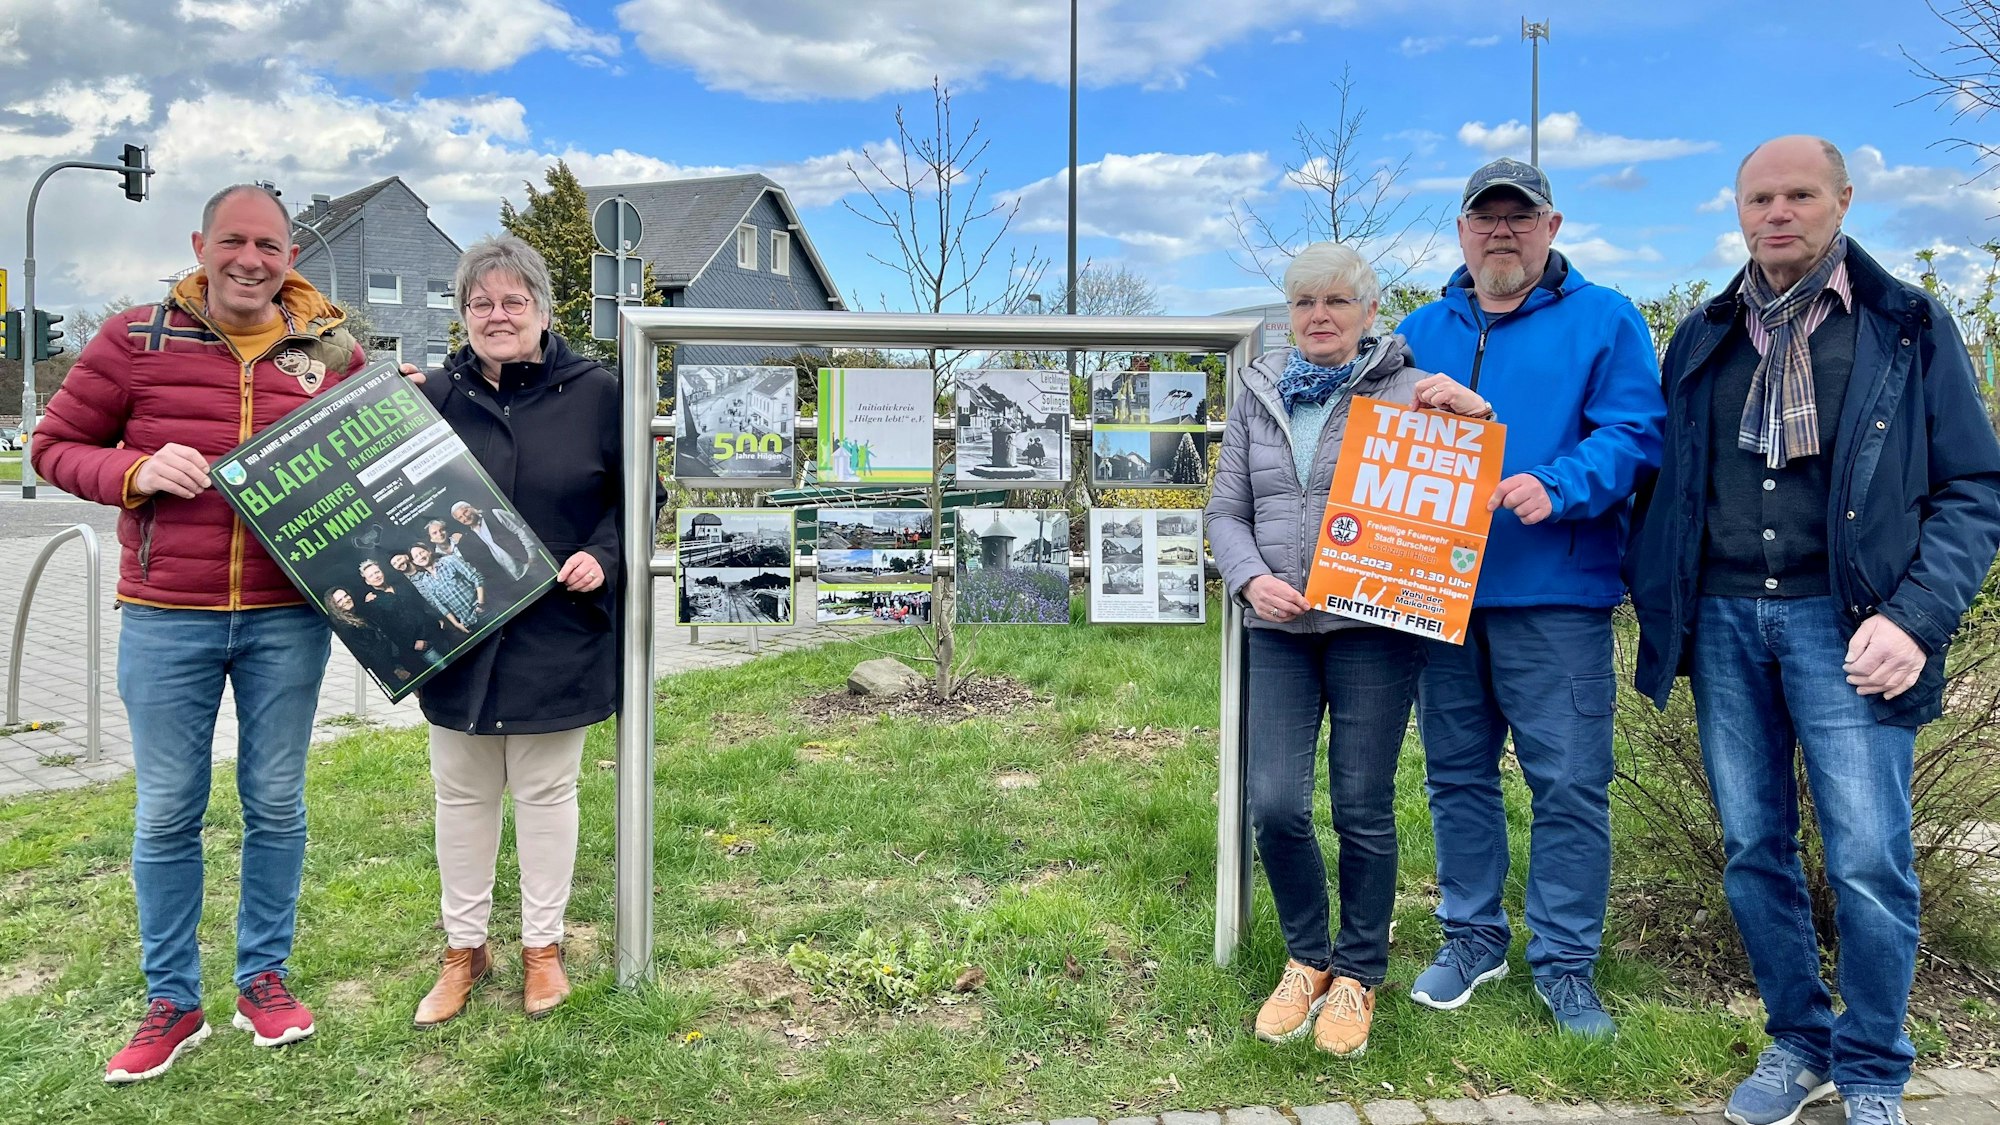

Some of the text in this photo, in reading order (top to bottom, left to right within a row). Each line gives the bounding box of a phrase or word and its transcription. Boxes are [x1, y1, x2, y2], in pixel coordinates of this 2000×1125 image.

[245, 453, 260, 466] 100
[259, 439, 281, 458] JAHRE
[279, 419, 312, 444] HILGENER
[310, 386, 366, 424] SCHÜTZENVEREIN
[381, 370, 394, 382] E.V.
[858, 403, 914, 411] Initiativkreis
[1042, 394, 1069, 407] Solingen
[347, 457, 361, 471] IN
[359, 412, 429, 463] KONZERTLÄNGE
[713, 432, 783, 460] 500
[1373, 404, 1485, 453] TANZ
[239, 442, 333, 516] BLÄCK
[326, 388, 420, 458] FÖÖSS
[735, 453, 782, 461] Jahre Hilgen
[1362, 435, 1480, 480] IN DEN
[1351, 462, 1475, 527] MAI
[323, 498, 373, 540] MIMO
[1367, 520, 1450, 545] Freiwillige Feuerwehr
[1374, 532, 1437, 553] Stadt Burscheid
[1413, 551, 1438, 565] Hilgen
[1321, 547, 1472, 589] 30.04.2023 19.30 Uhr
[1332, 561, 1437, 592] Feuerwehrgerätehaus
[1439, 586, 1469, 600] Hilgen
[1327, 595, 1443, 633] EINTRITT FREI
[1395, 596, 1446, 614] Maikönigin
[1402, 589, 1443, 605] Wahl der
